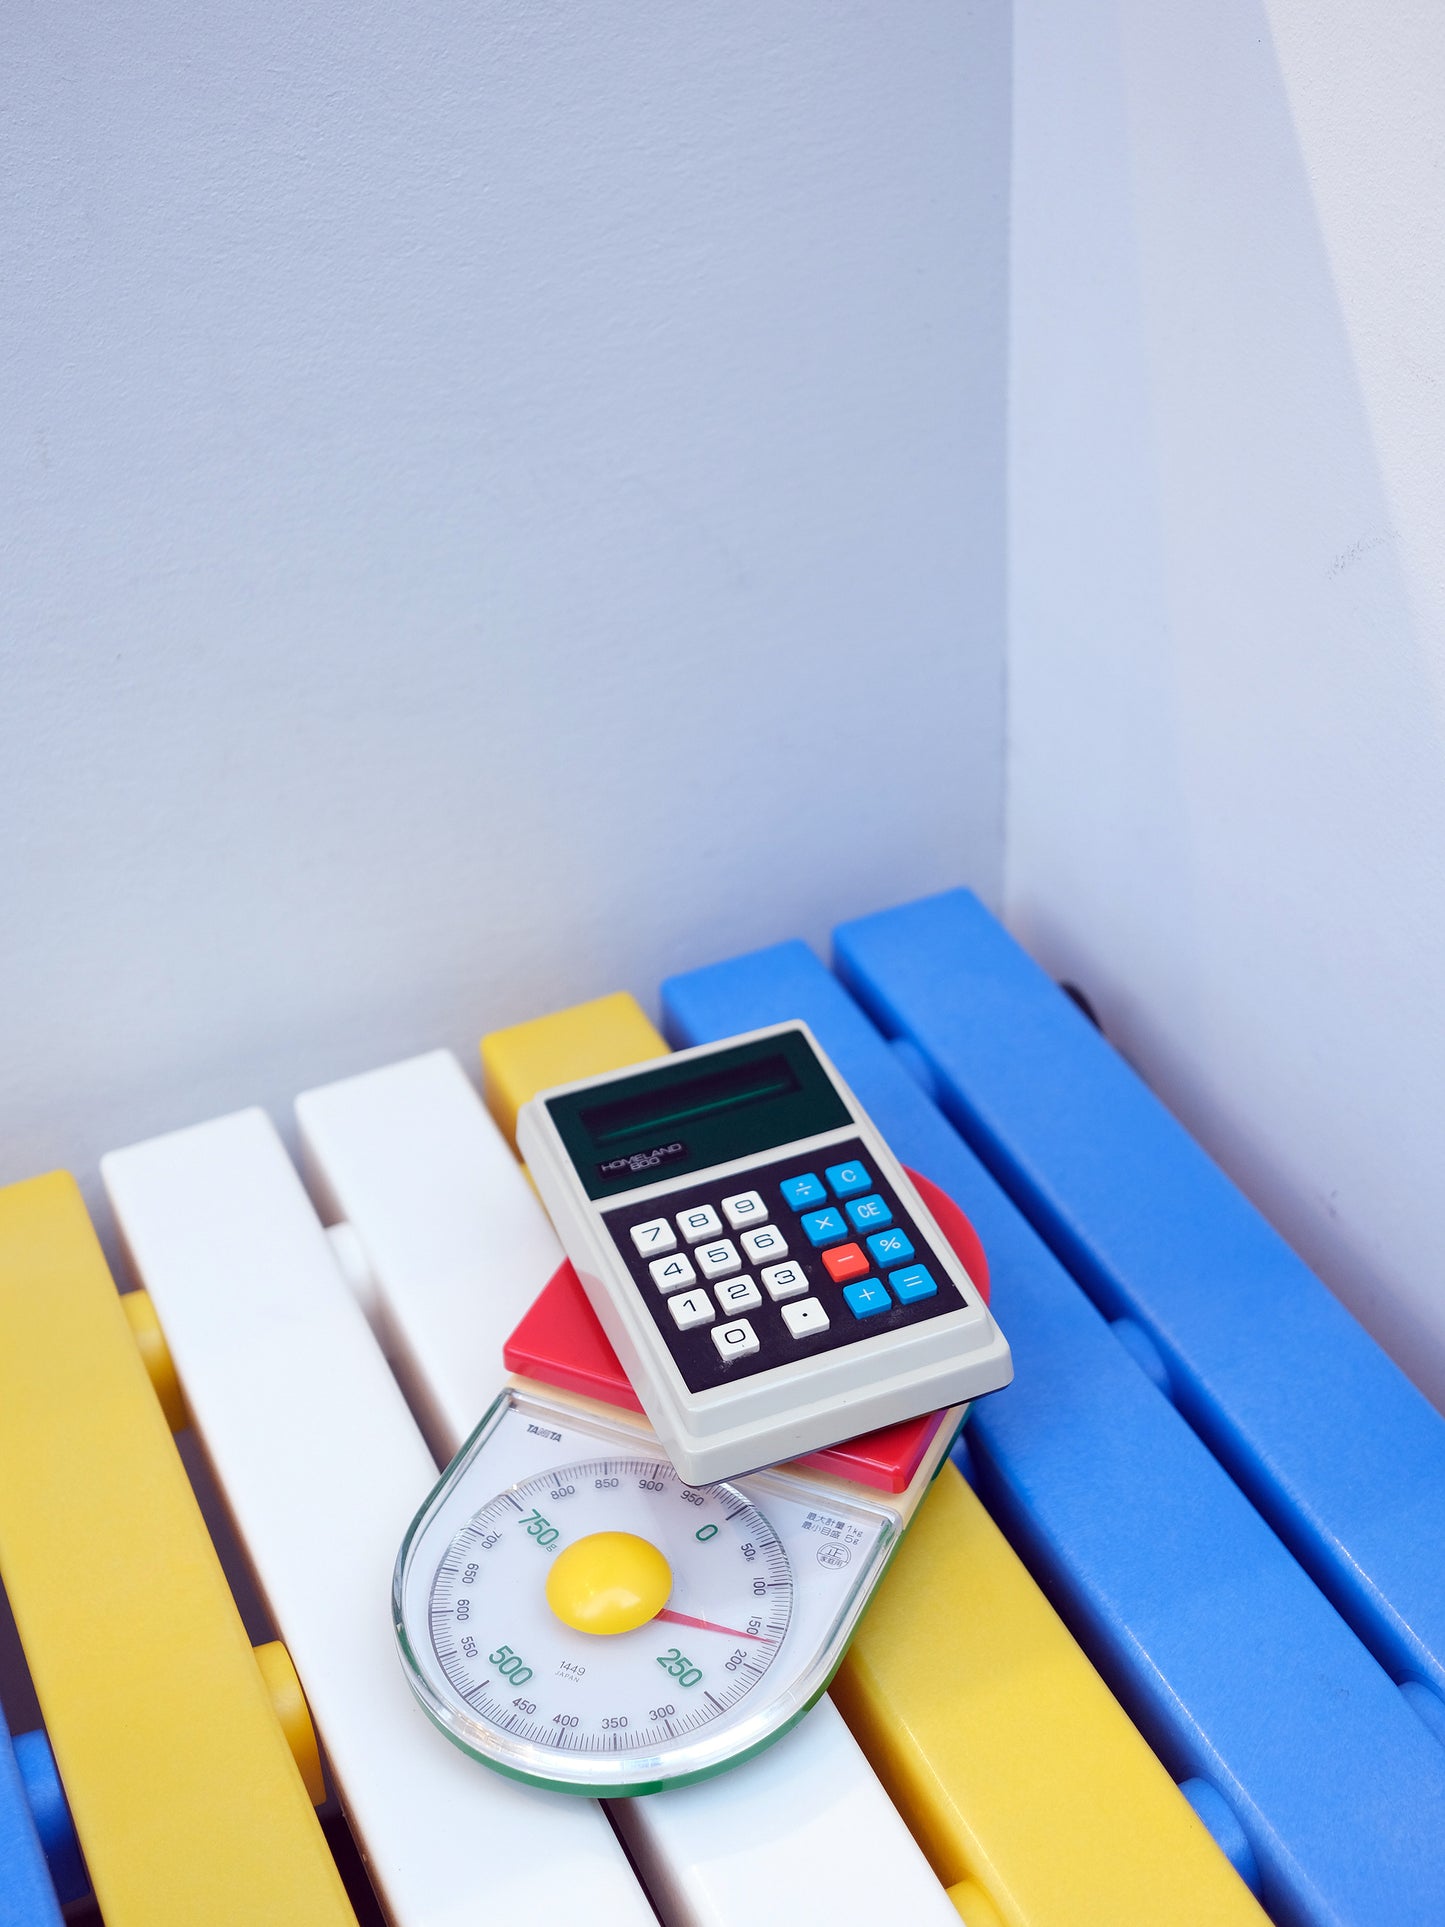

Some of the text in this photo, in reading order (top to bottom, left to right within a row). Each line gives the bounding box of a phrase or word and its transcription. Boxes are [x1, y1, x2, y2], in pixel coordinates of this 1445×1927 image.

[601, 1143, 682, 1172] HOMELAND
[841, 1169, 857, 1183] C
[735, 1199, 755, 1213] 9
[857, 1202, 880, 1219] CE
[688, 1213, 709, 1228] 8
[642, 1227, 660, 1242] 7
[753, 1234, 775, 1248] 6
[879, 1236, 901, 1252] %
[707, 1247, 729, 1263] 5
[664, 1262, 684, 1276] 4
[774, 1269, 796, 1285] 3
[728, 1284, 750, 1300] 2
[683, 1299, 697, 1312] 1
[724, 1328, 746, 1344] 0
[526, 1424, 562, 1443] TANITA
[595, 1478, 619, 1489] 850
[638, 1479, 664, 1492] 900
[550, 1485, 576, 1500] 800
[680, 1490, 705, 1506] 950
[481, 1529, 503, 1550] 700
[695, 1523, 719, 1542] 0
[827, 1544, 845, 1558] 正
[462, 1563, 479, 1584] 650
[753, 1577, 767, 1596] 100
[456, 1599, 470, 1621] 600
[746, 1615, 763, 1636] 150
[461, 1636, 478, 1658] 550
[489, 1645, 533, 1686] 500
[656, 1648, 703, 1688] 250
[725, 1648, 747, 1672] 200
[559, 1660, 587, 1677] 1449
[554, 1670, 580, 1684] JAPAN
[512, 1697, 537, 1715] 450
[649, 1704, 675, 1721] 300
[552, 1714, 579, 1728] 400
[601, 1716, 628, 1729] 350
